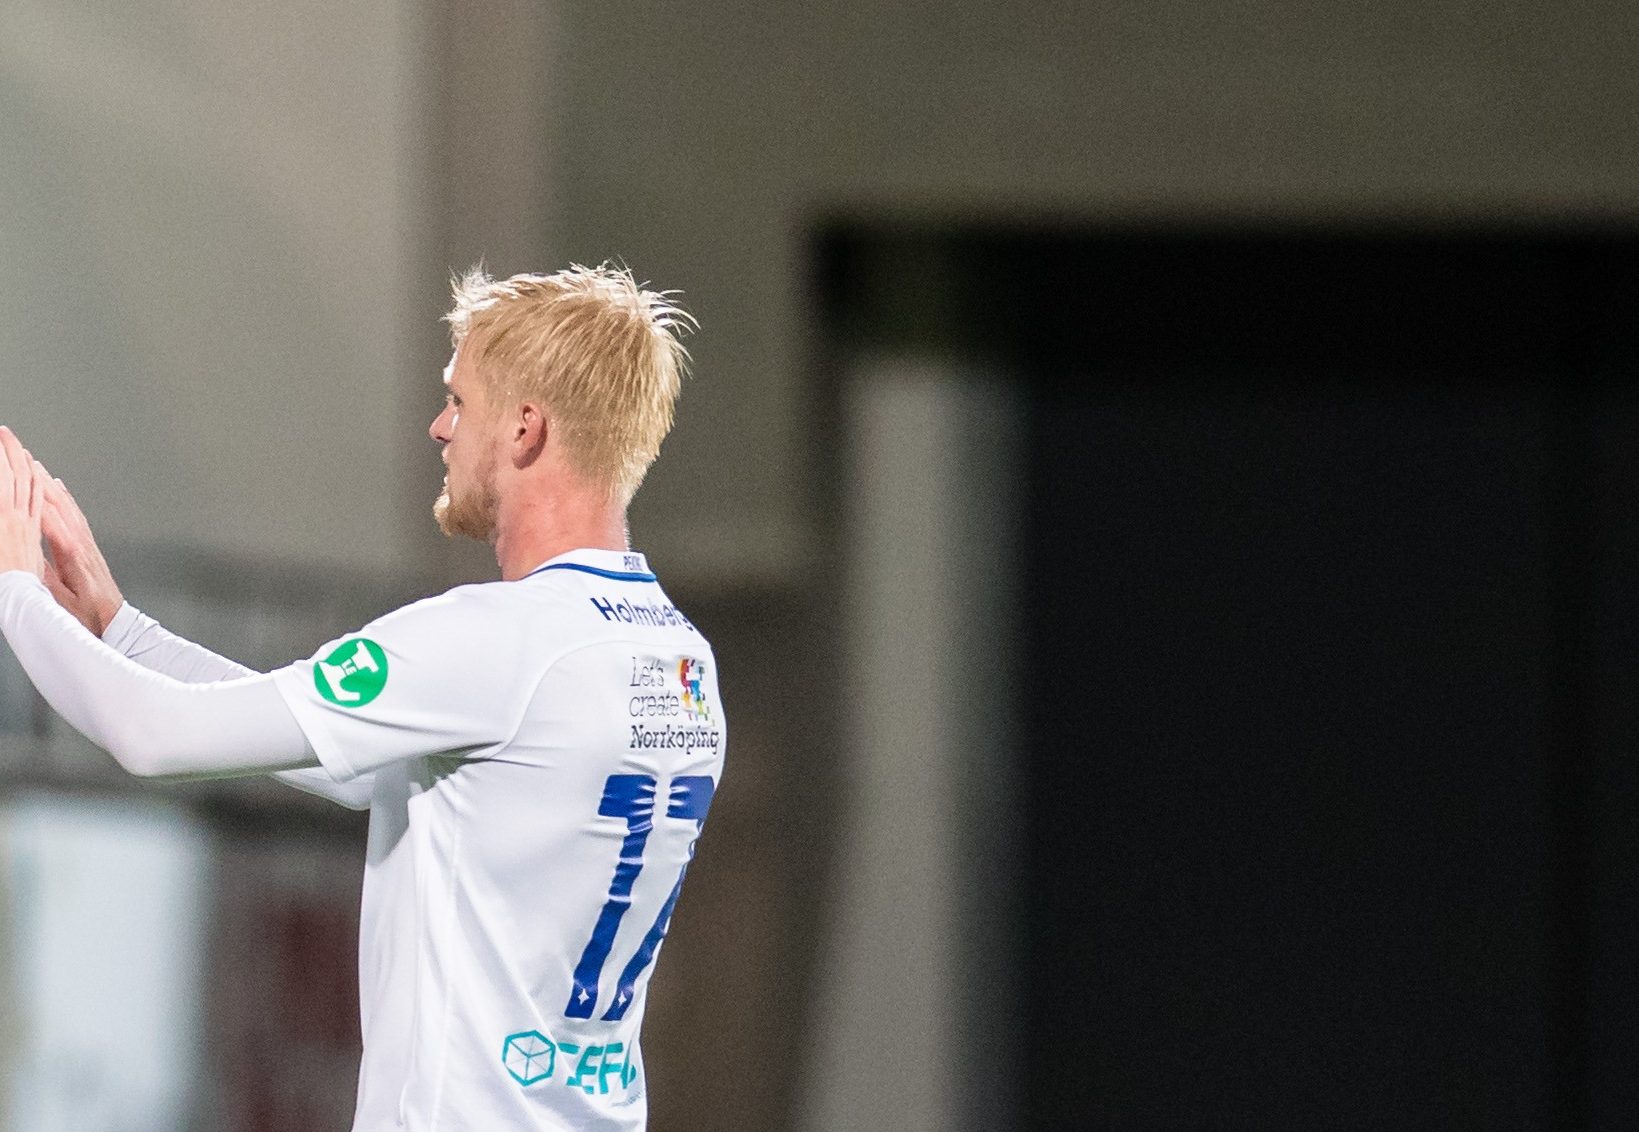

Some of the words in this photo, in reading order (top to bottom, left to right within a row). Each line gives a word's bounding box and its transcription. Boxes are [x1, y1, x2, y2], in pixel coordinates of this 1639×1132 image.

[629, 690, 679, 717] create
[630, 724, 719, 755] Norrköping
[565, 774, 715, 1021] 17
